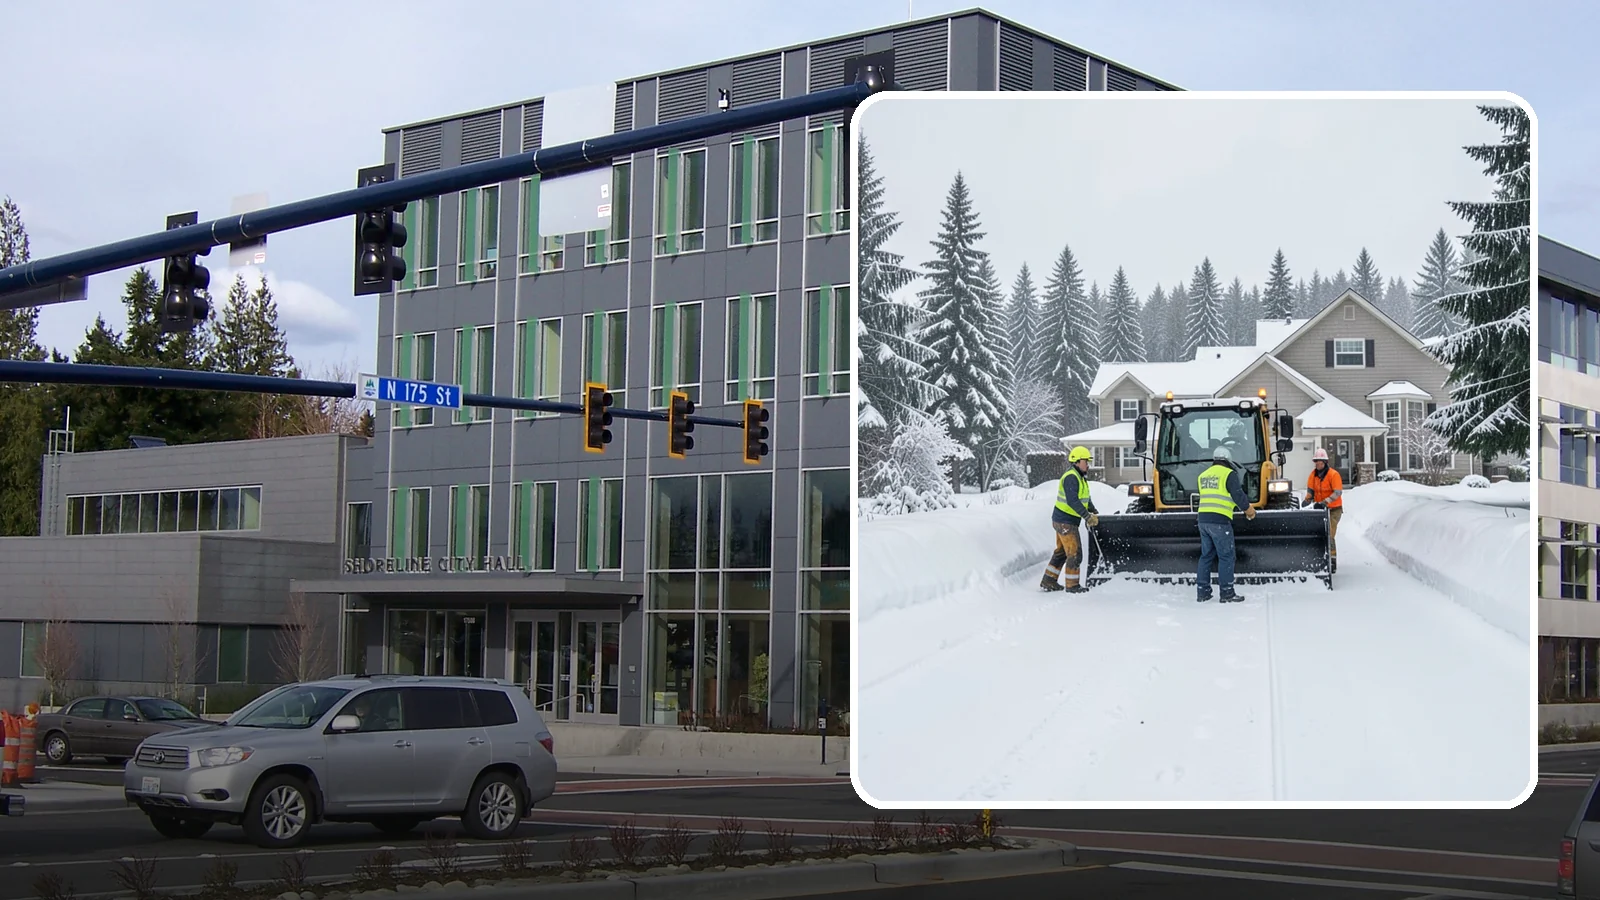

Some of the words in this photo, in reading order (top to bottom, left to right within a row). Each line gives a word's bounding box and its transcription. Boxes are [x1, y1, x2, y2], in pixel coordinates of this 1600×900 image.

[387, 381, 397, 400] N
[405, 382, 428, 403] 175
[436, 386, 451, 406] St
[344, 556, 432, 574] SHORELINE
[438, 556, 475, 572] CITY
[484, 555, 525, 571] HALL
